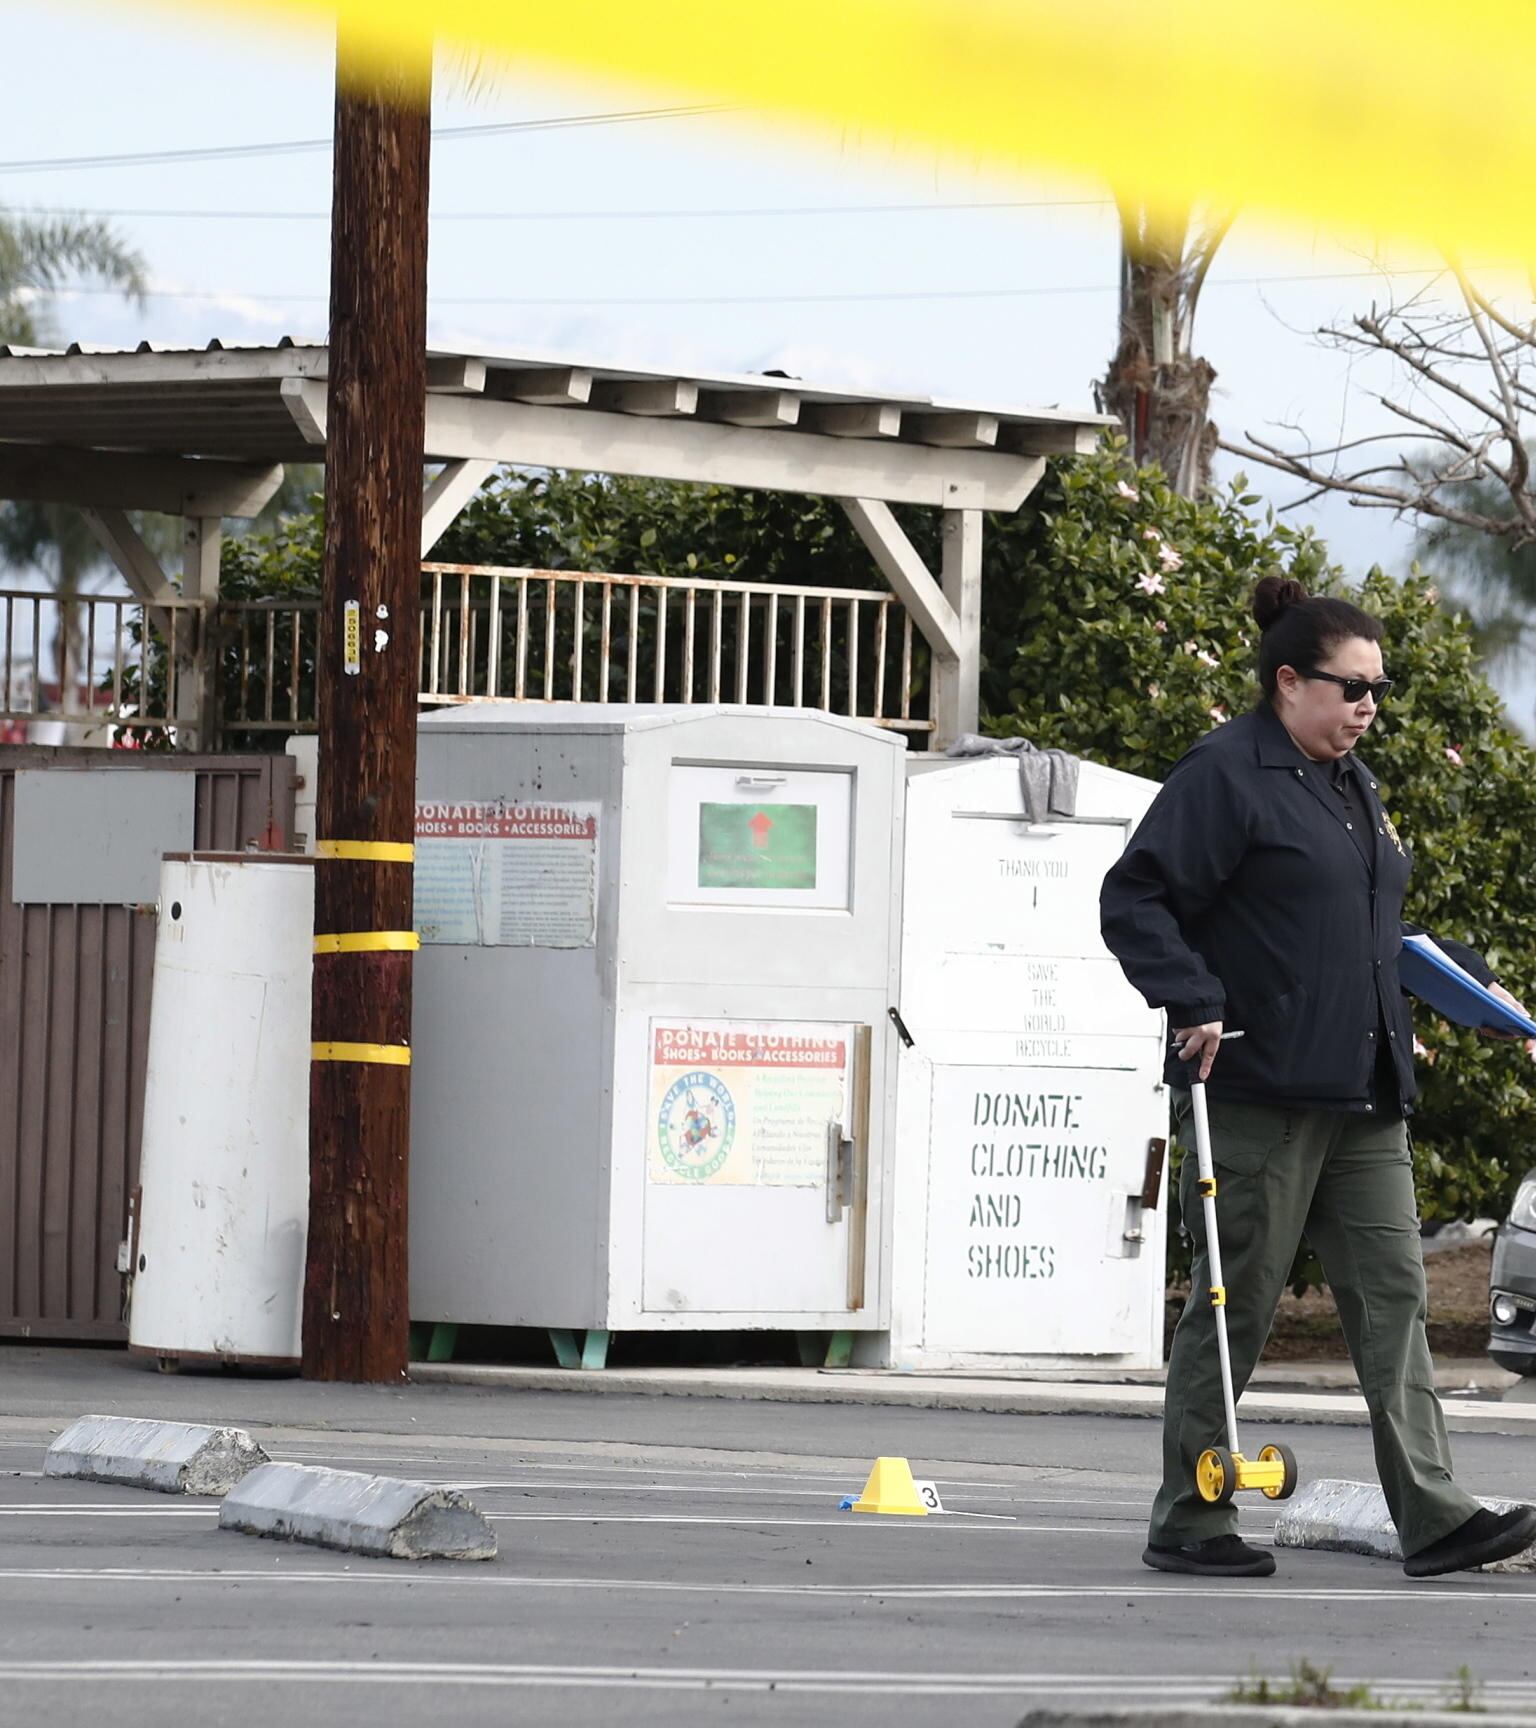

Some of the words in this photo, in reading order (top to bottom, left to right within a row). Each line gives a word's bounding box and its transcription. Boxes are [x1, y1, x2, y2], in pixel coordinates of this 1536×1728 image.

[998, 858, 1040, 878] THANK
[1043, 860, 1069, 878] YOU
[1027, 962, 1058, 981] SAVE
[1032, 989, 1056, 1007] THE
[1023, 1014, 1065, 1032] WORLD
[662, 1030, 736, 1048] DONATE
[746, 1034, 837, 1050] CLOTHING
[1016, 1039, 1072, 1057] RECYCLE
[711, 1050, 753, 1062] BOOKS
[973, 1092, 1083, 1128] DONATE
[971, 1143, 1107, 1179] CLOTHING
[969, 1193, 1021, 1228] AND
[967, 1244, 1055, 1279] SHOES
